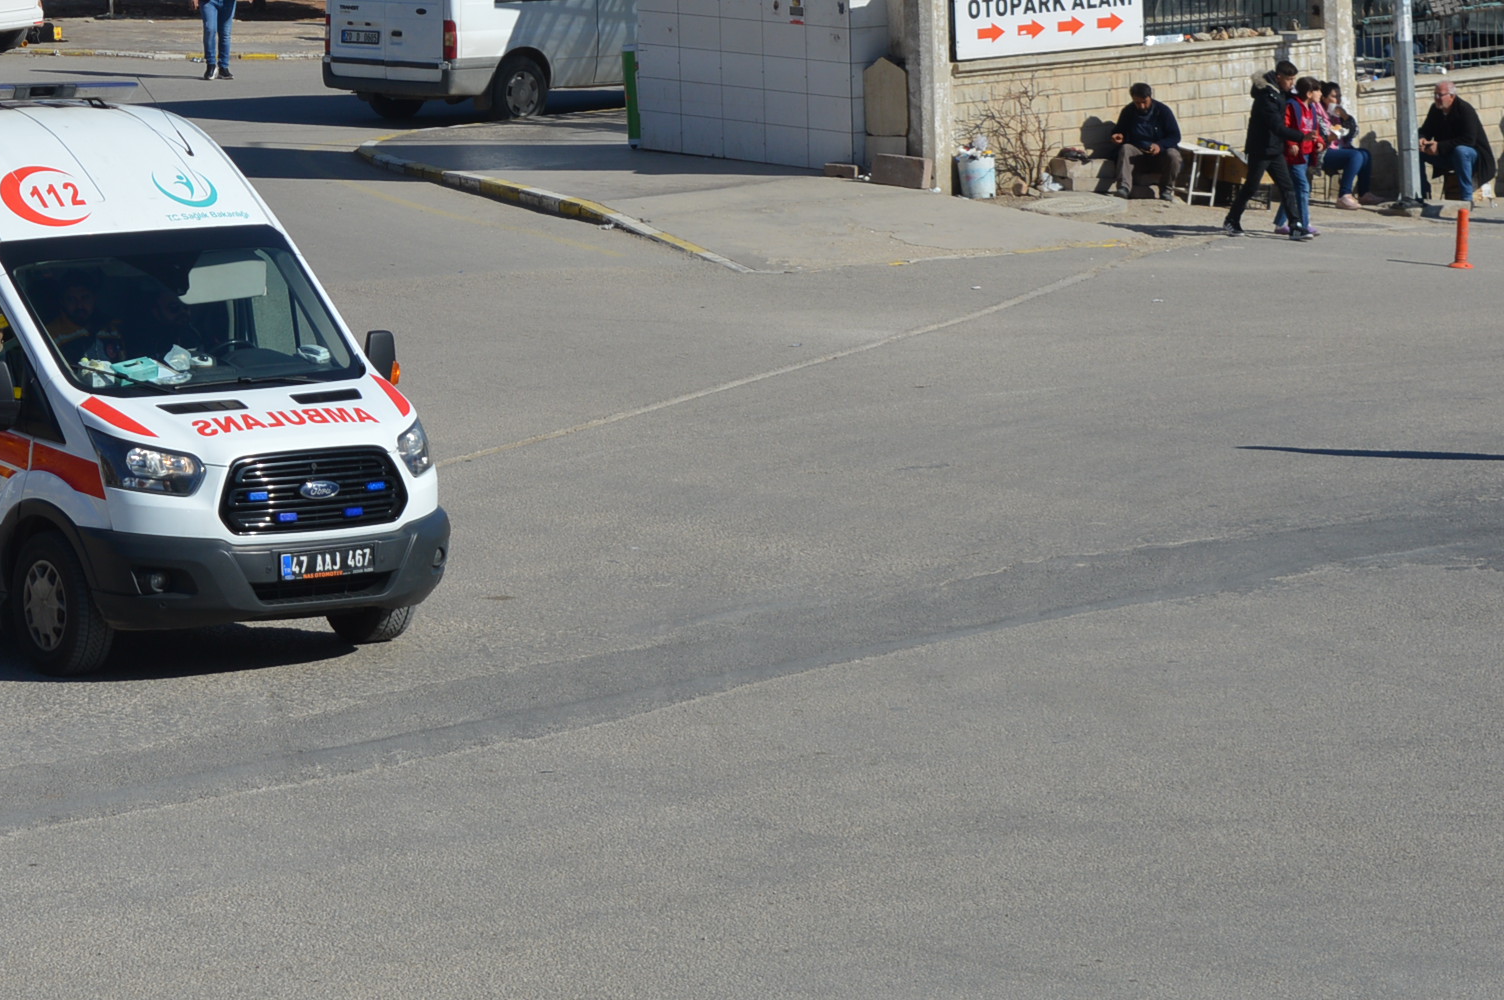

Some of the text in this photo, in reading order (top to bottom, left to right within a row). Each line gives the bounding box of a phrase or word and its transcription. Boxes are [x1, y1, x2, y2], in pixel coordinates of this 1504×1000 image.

[29, 182, 87, 209] 112
[181, 212, 209, 221] Sağlık
[209, 210, 250, 219] Bakanlığı
[292, 556, 308, 574] 47
[316, 552, 341, 572] AAJ
[347, 548, 371, 568] 467
